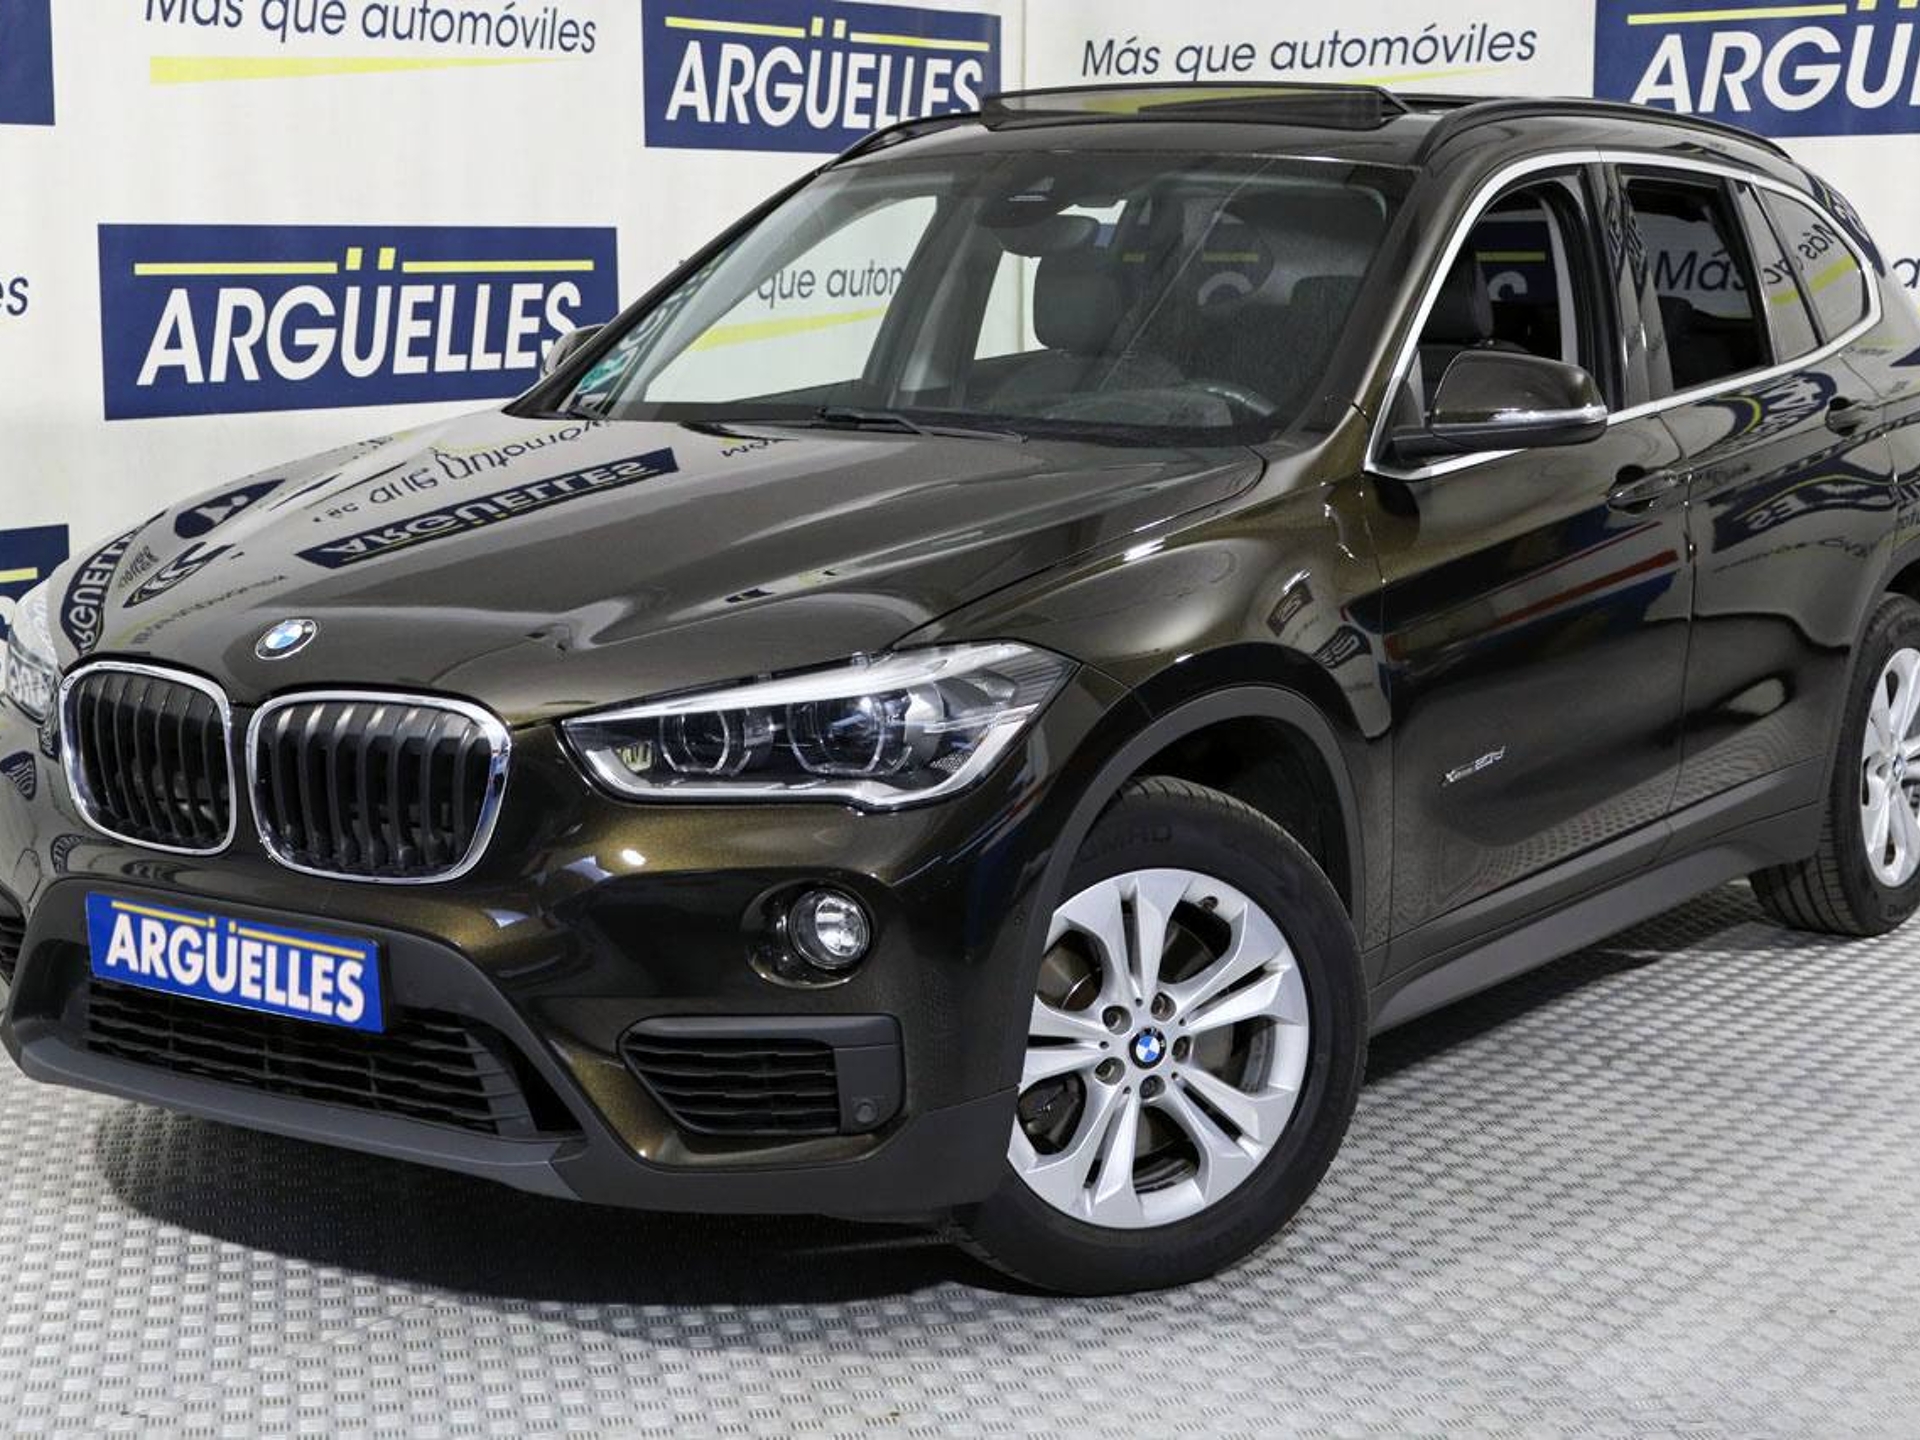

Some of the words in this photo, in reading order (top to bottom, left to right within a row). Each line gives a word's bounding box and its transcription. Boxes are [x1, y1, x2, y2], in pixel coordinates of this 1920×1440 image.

[261, 0, 346, 43] que
[361, 0, 597, 54] automóviles
[664, 16, 984, 129] ARGÜELLES
[1081, 36, 1161, 77] Más
[1175, 42, 1256, 81] que
[1270, 23, 1537, 71] automóviles
[1629, 0, 1920, 114] ARGÜ
[136, 247, 582, 386] ARGÜELLES
[106, 913, 366, 1023] ARGÜELLES
